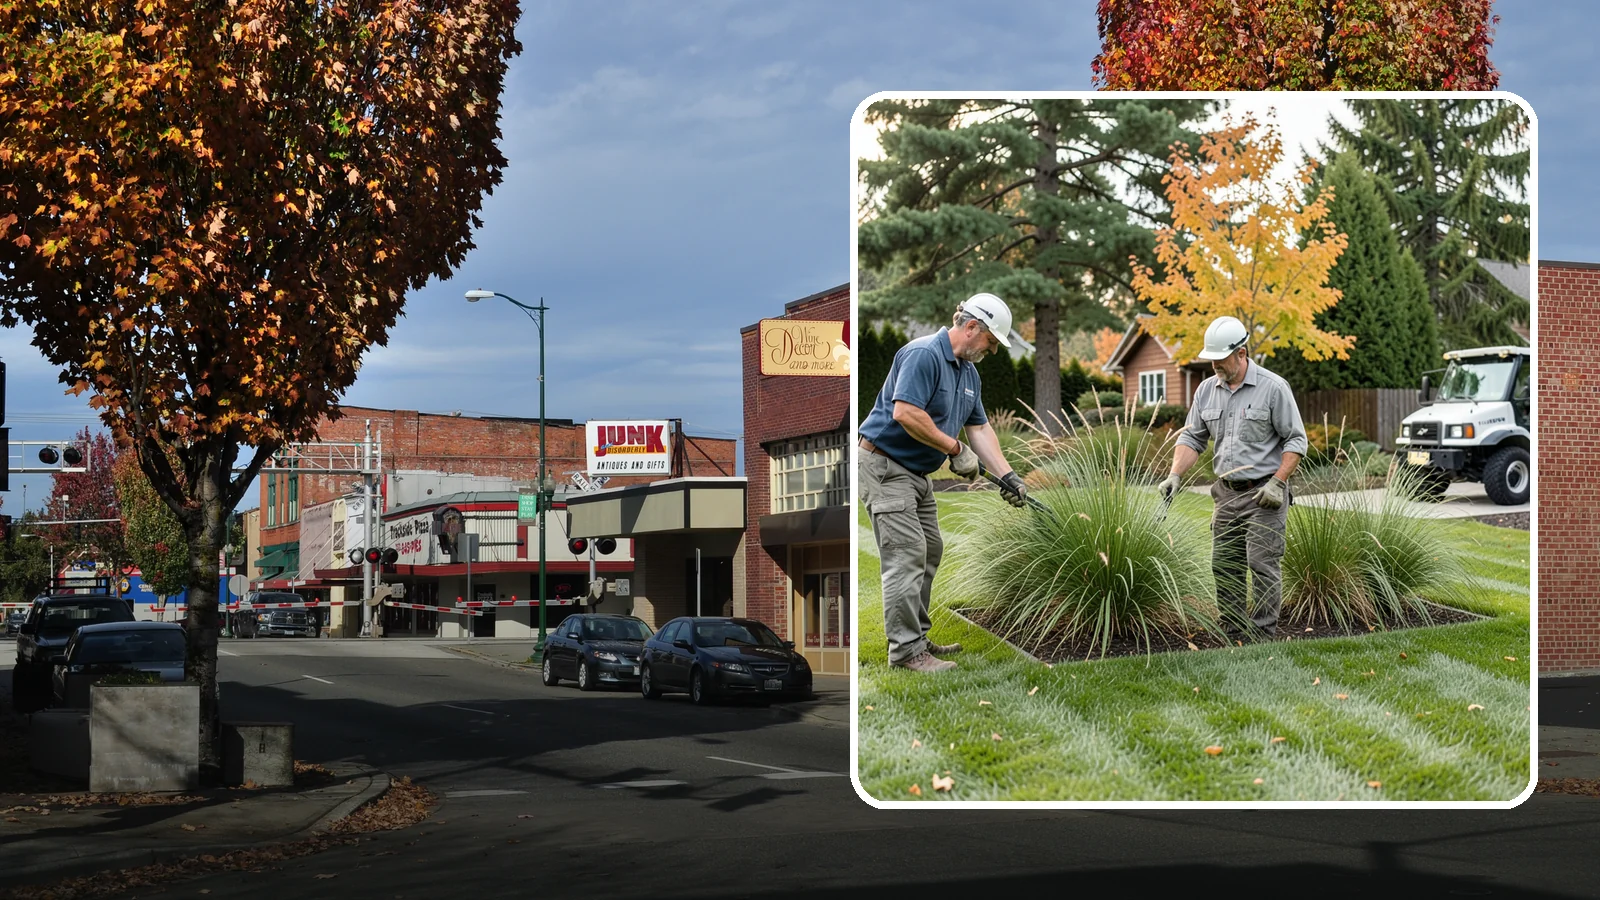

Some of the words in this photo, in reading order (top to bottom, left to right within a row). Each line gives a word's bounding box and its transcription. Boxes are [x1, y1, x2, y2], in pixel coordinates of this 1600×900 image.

[596, 425, 664, 457] JUNK
[607, 446, 646, 454] DISORDERLY
[596, 461, 628, 470] ANTIQUES
[631, 461, 644, 470] AND
[646, 460, 665, 469] GIFTS
[414, 519, 429, 535] Pizza
